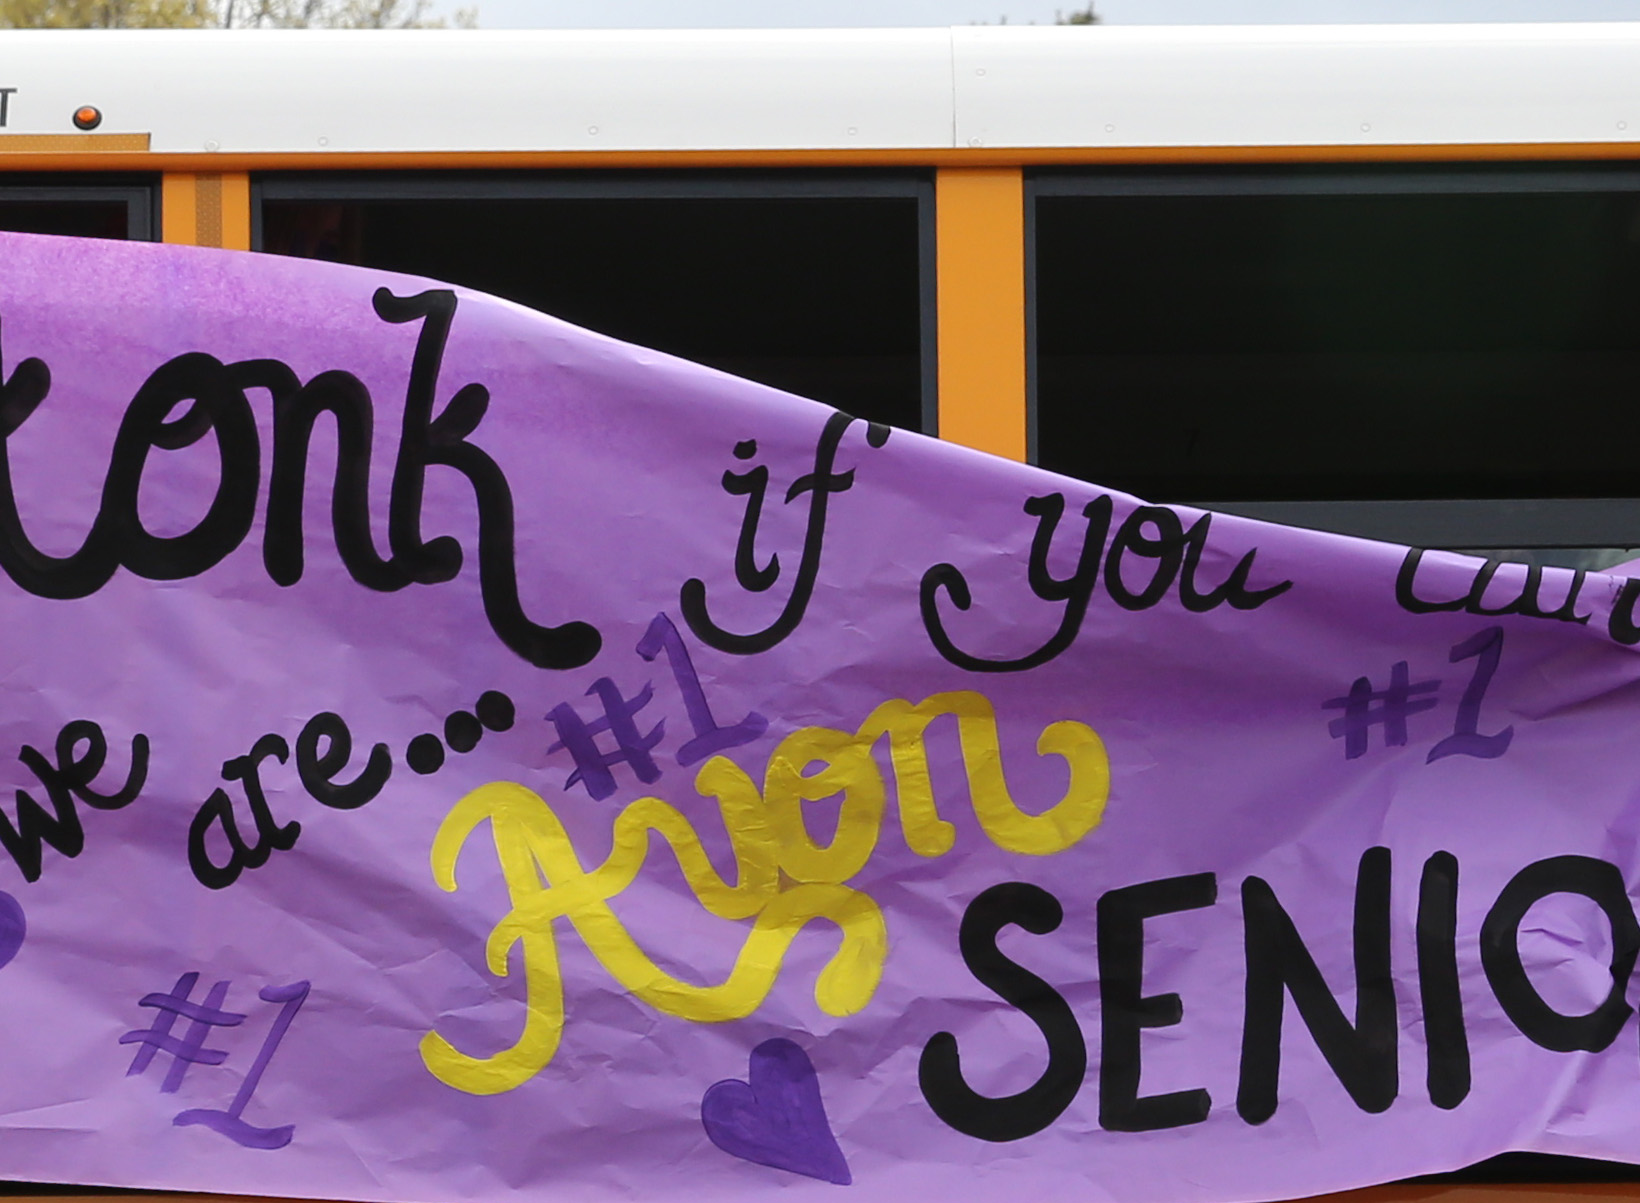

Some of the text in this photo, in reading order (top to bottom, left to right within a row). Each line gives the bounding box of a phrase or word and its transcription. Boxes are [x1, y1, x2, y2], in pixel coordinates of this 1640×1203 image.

[680, 411, 890, 656] if
[920, 492, 1293, 673] you
[545, 611, 767, 800] #1
[1322, 626, 1515, 764] #1
[418, 691, 1109, 1096] Avon
[119, 972, 310, 1151] #1
